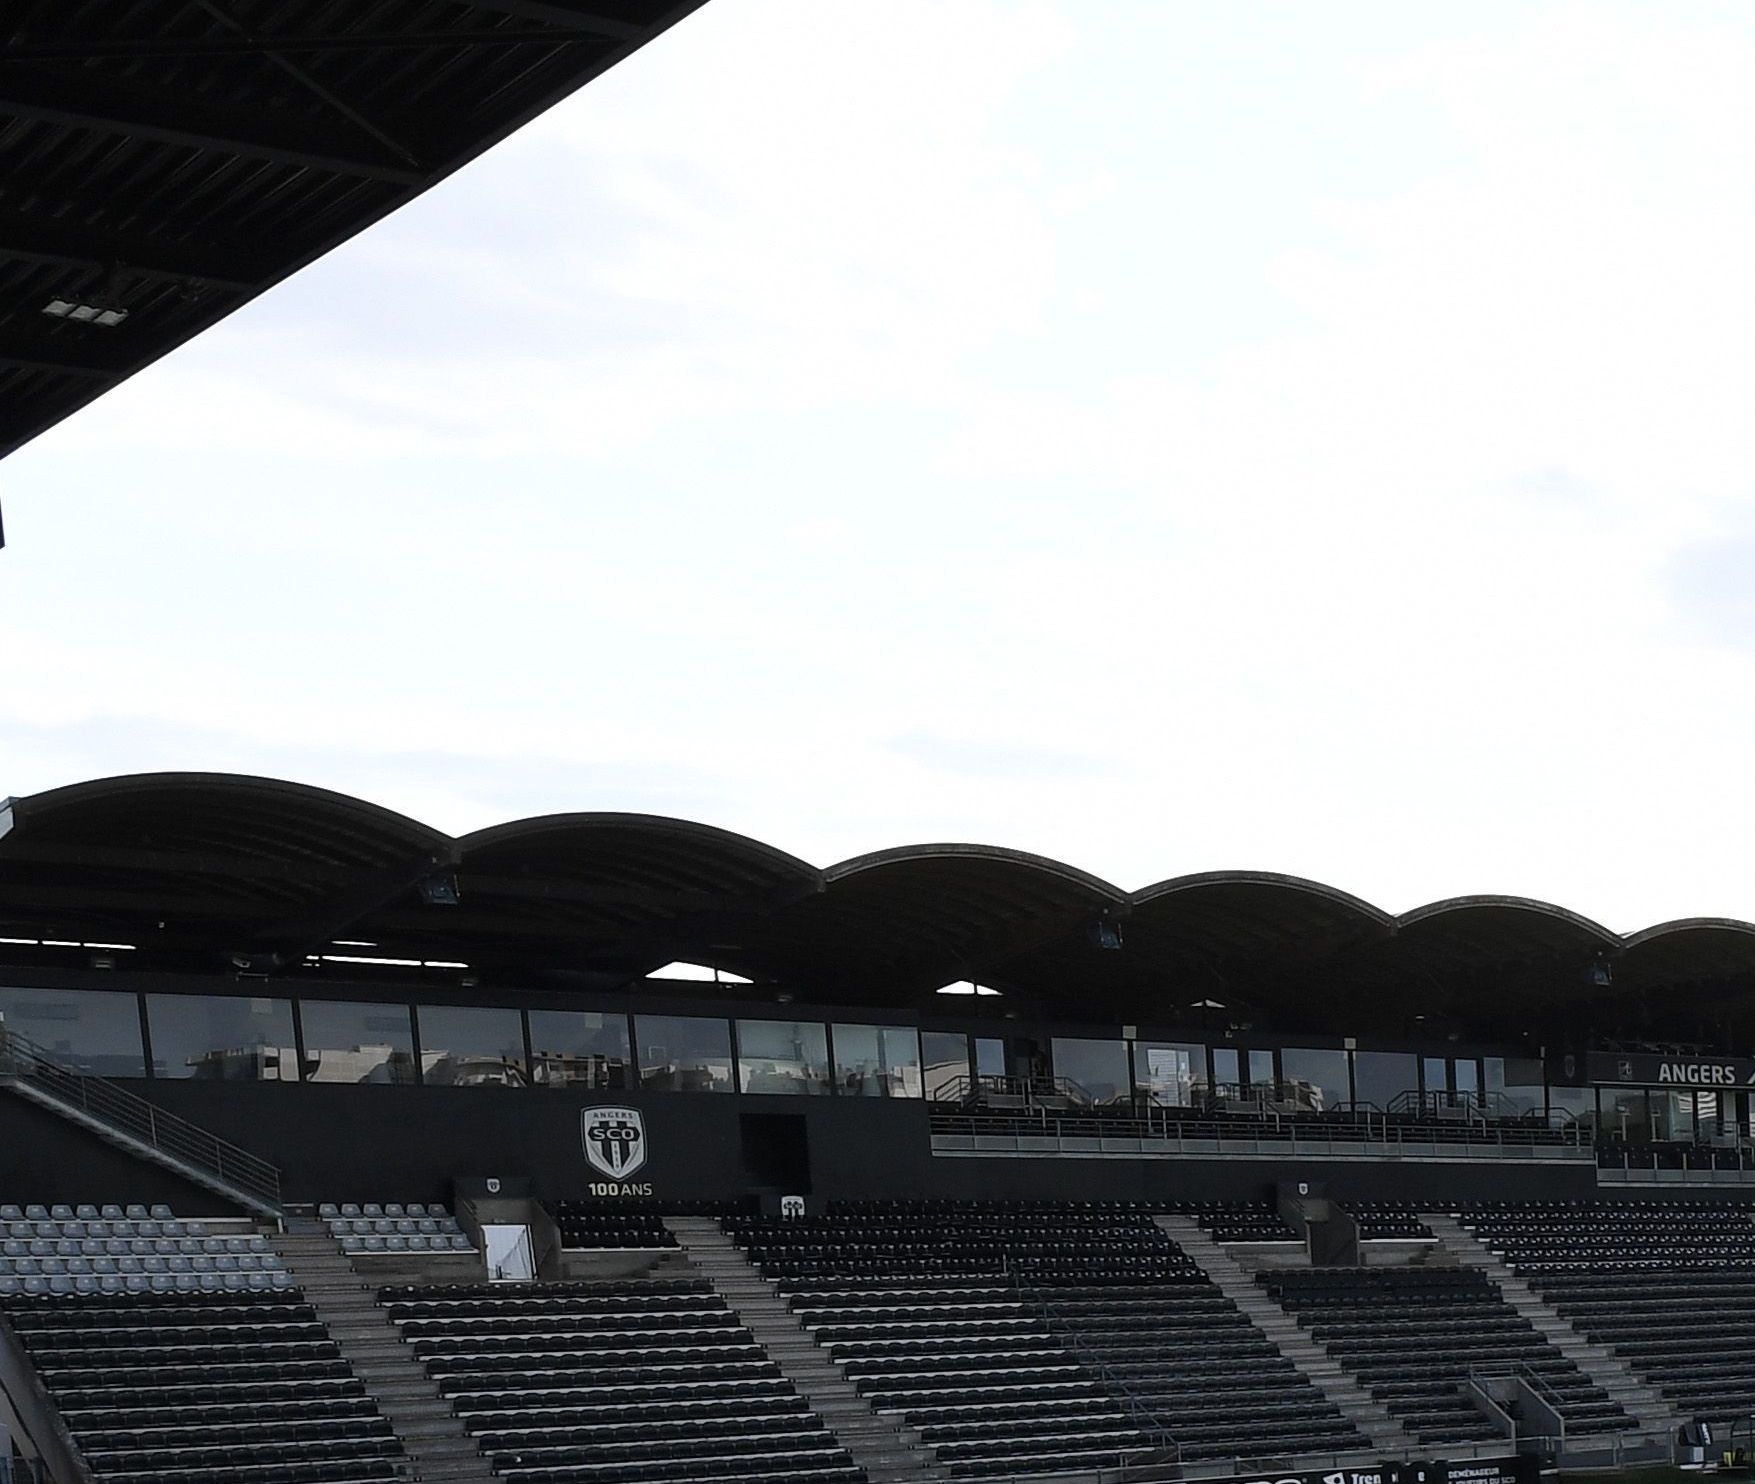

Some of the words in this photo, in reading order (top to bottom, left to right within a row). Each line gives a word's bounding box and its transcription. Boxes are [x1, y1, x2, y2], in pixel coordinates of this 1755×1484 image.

[1658, 1063, 1736, 1084] ANGERS
[593, 1128, 634, 1140] SCO
[588, 1182, 619, 1196] 100
[621, 1183, 653, 1196] ANS
